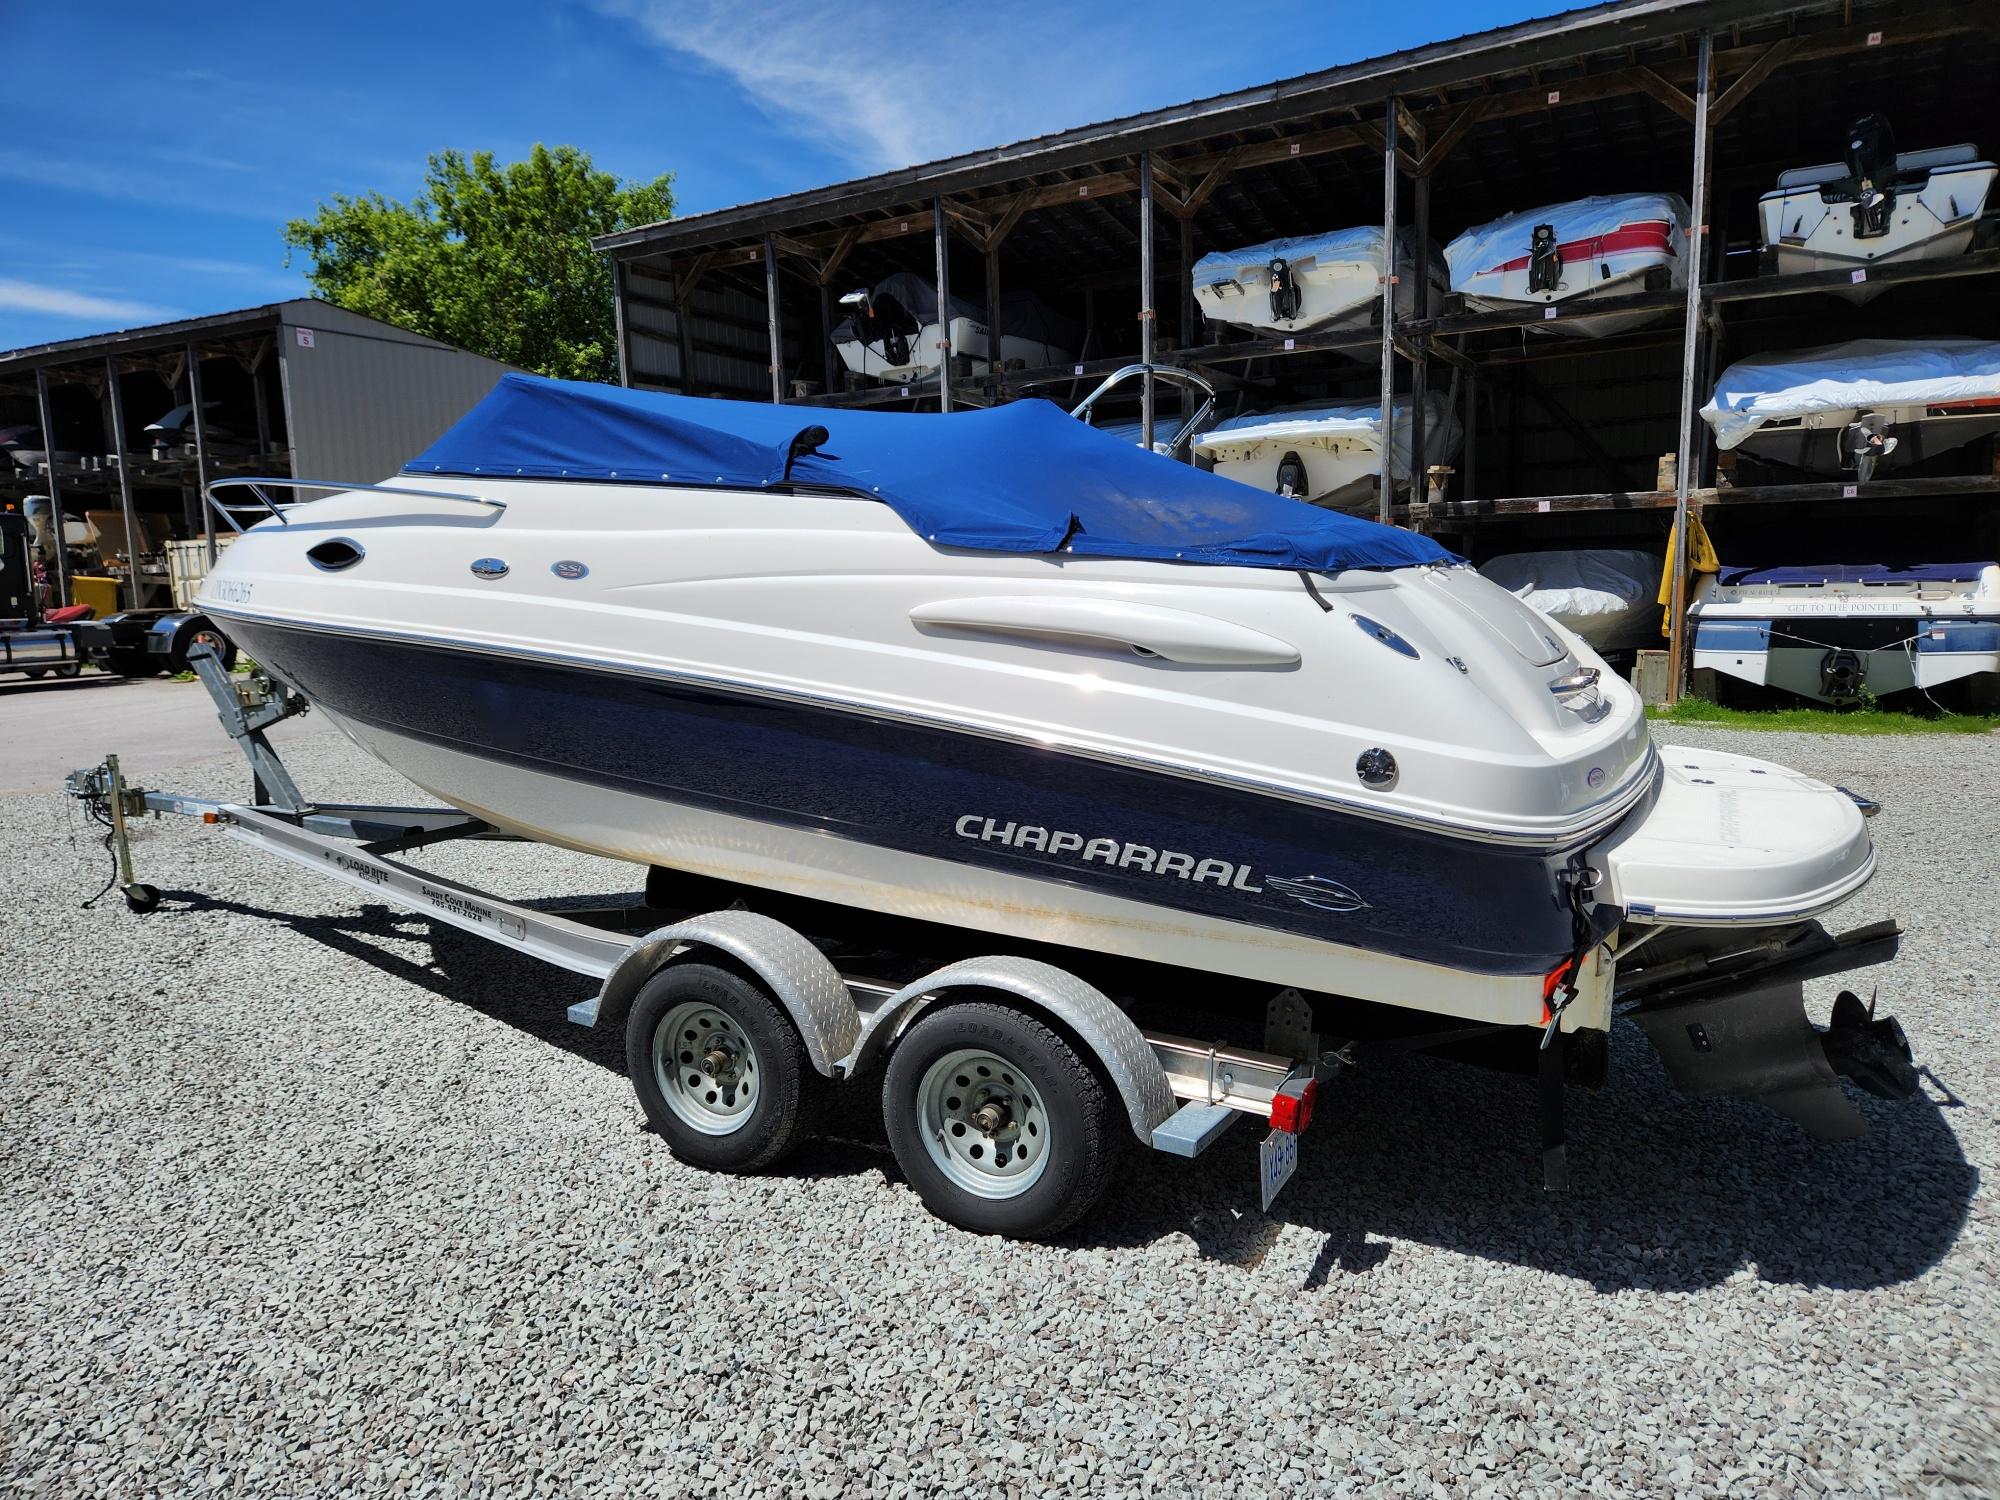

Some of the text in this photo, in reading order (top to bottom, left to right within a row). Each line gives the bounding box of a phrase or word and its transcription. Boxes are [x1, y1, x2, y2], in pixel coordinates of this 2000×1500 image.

[303, 336, 310, 345] 5
[1810, 603, 1825, 612] TO
[1828, 603, 1847, 612] THE
[1851, 603, 1888, 612] POINTE
[954, 814, 1263, 894] CHAPARRAL
[350, 859, 371, 875] LOAD
[371, 867, 389, 882] RITE
[431, 898, 483, 922] 705-431-2628
